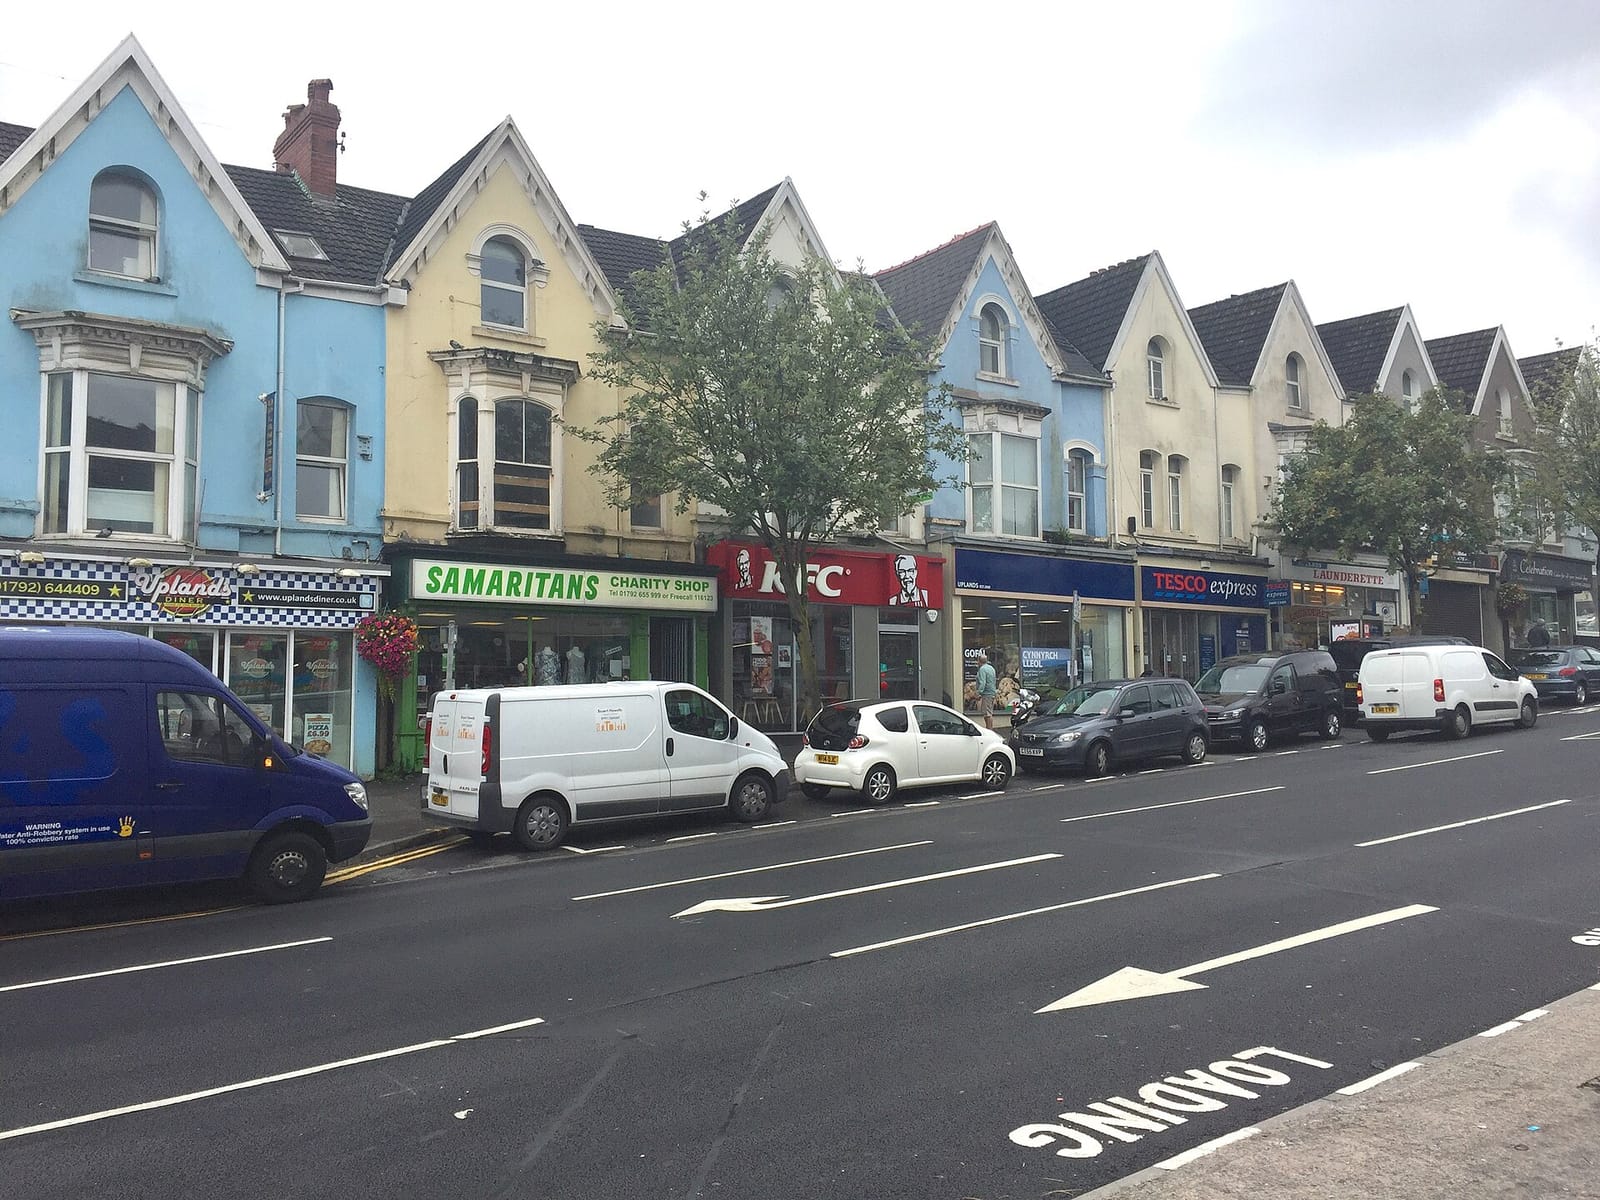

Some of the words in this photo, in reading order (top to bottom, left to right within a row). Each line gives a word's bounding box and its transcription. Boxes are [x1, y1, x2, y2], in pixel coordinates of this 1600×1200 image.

[758, 560, 844, 598] KFC
[1313, 569, 1384, 585] LAUNDERETTE
[0, 581, 41, 594] 1792)
[45, 583, 100, 596] 644409
[134, 573, 232, 603] Uplands
[426, 566, 599, 600] SAMARITANS
[610, 576, 671, 591] CHARITY
[674, 580, 710, 592] SHOP
[957, 581, 979, 589] UPLANDS
[1153, 572, 1207, 593] TESCO
[1210, 580, 1257, 600] express
[257, 593, 357, 605] www.uplandsdiner.co.uk
[620, 590, 637, 598] 01792
[1266, 591, 1288, 599] express
[165, 596, 204, 604] DINER
[1022, 650, 1058, 660] CYNNYRCH
[1022, 660, 1043, 668] LLEOL
[307, 730, 330, 738] £6.99
[25, 823, 61, 831] WARNING
[17, 828, 63, 838] Anti-Robbery
[64, 828, 89, 836] system
[6, 837, 26, 845] 100%
[27, 834, 63, 844] conviction
[1008, 1046, 1334, 1158] LOADING
